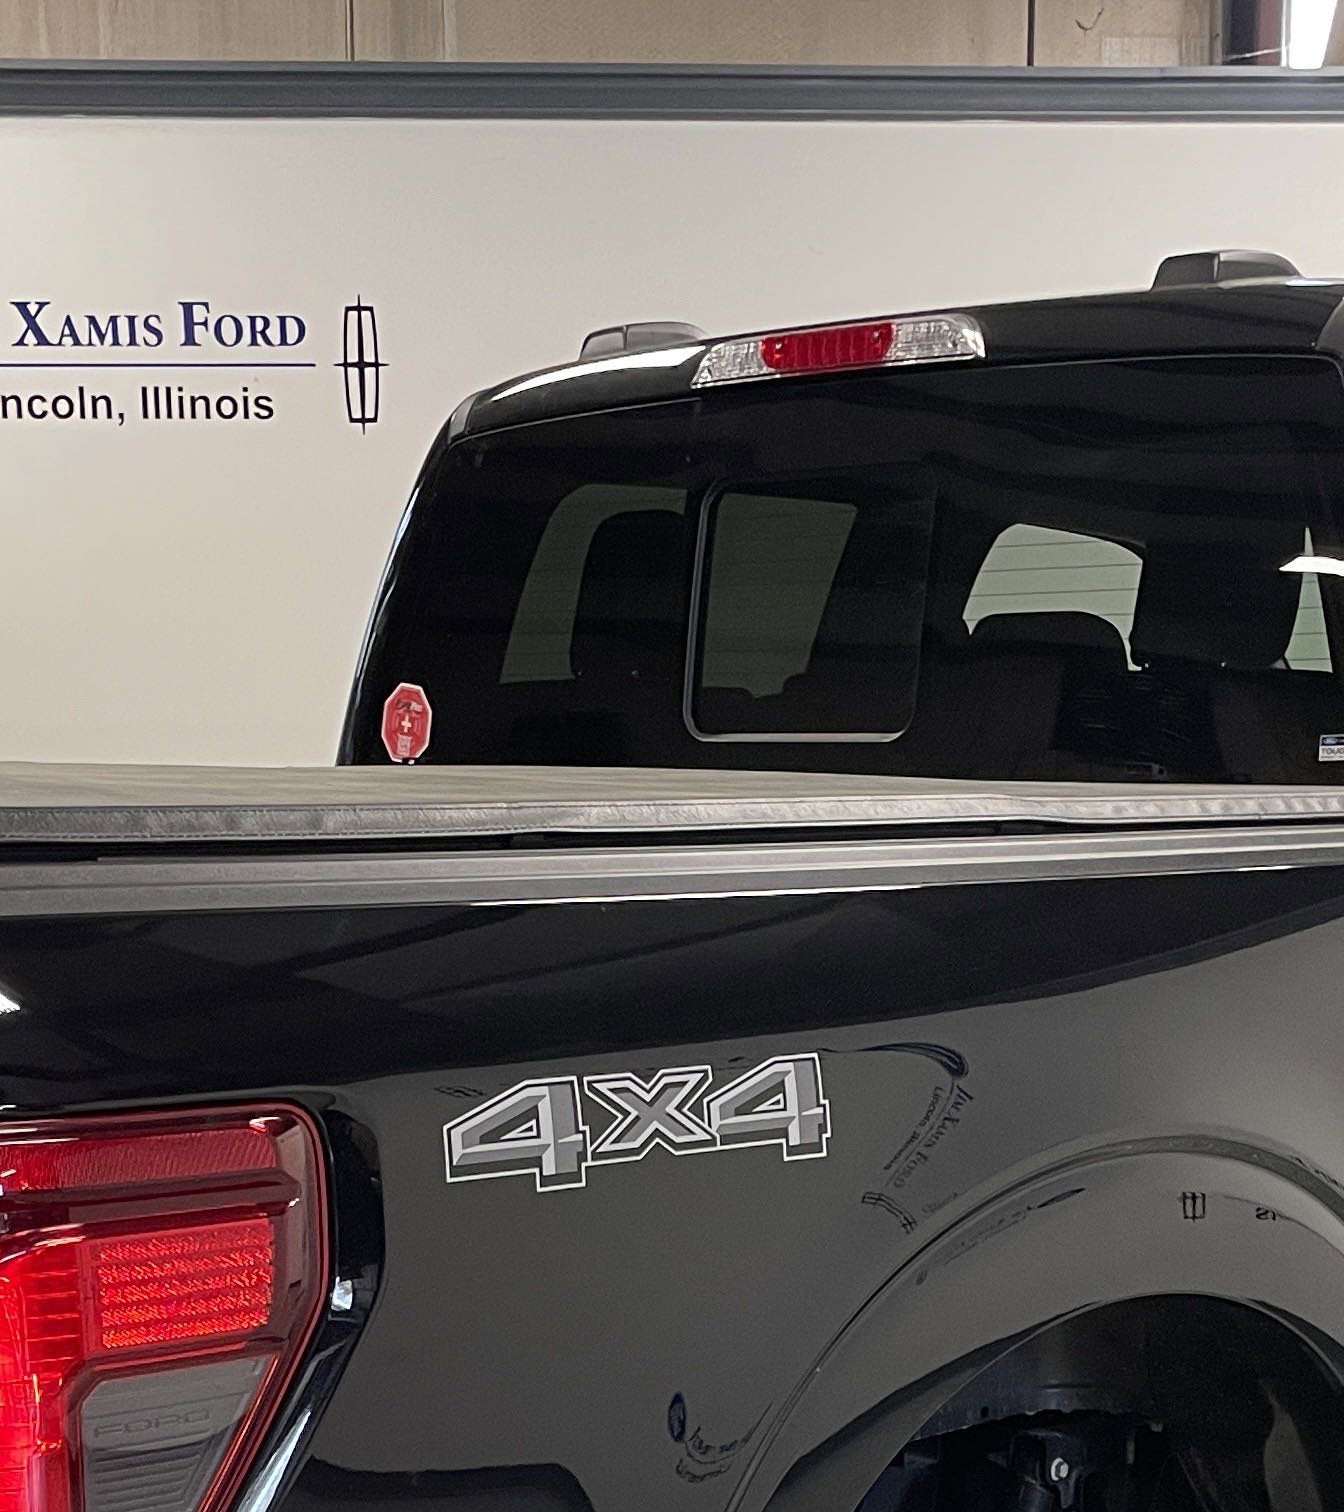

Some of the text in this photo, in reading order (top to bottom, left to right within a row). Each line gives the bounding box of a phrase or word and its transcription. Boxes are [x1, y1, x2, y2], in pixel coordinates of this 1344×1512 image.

[9, 301, 164, 348] XAMIS
[177, 300, 307, 348] FORD
[140, 385, 276, 421] Illinois
[94, 1408, 210, 1438] FORD
